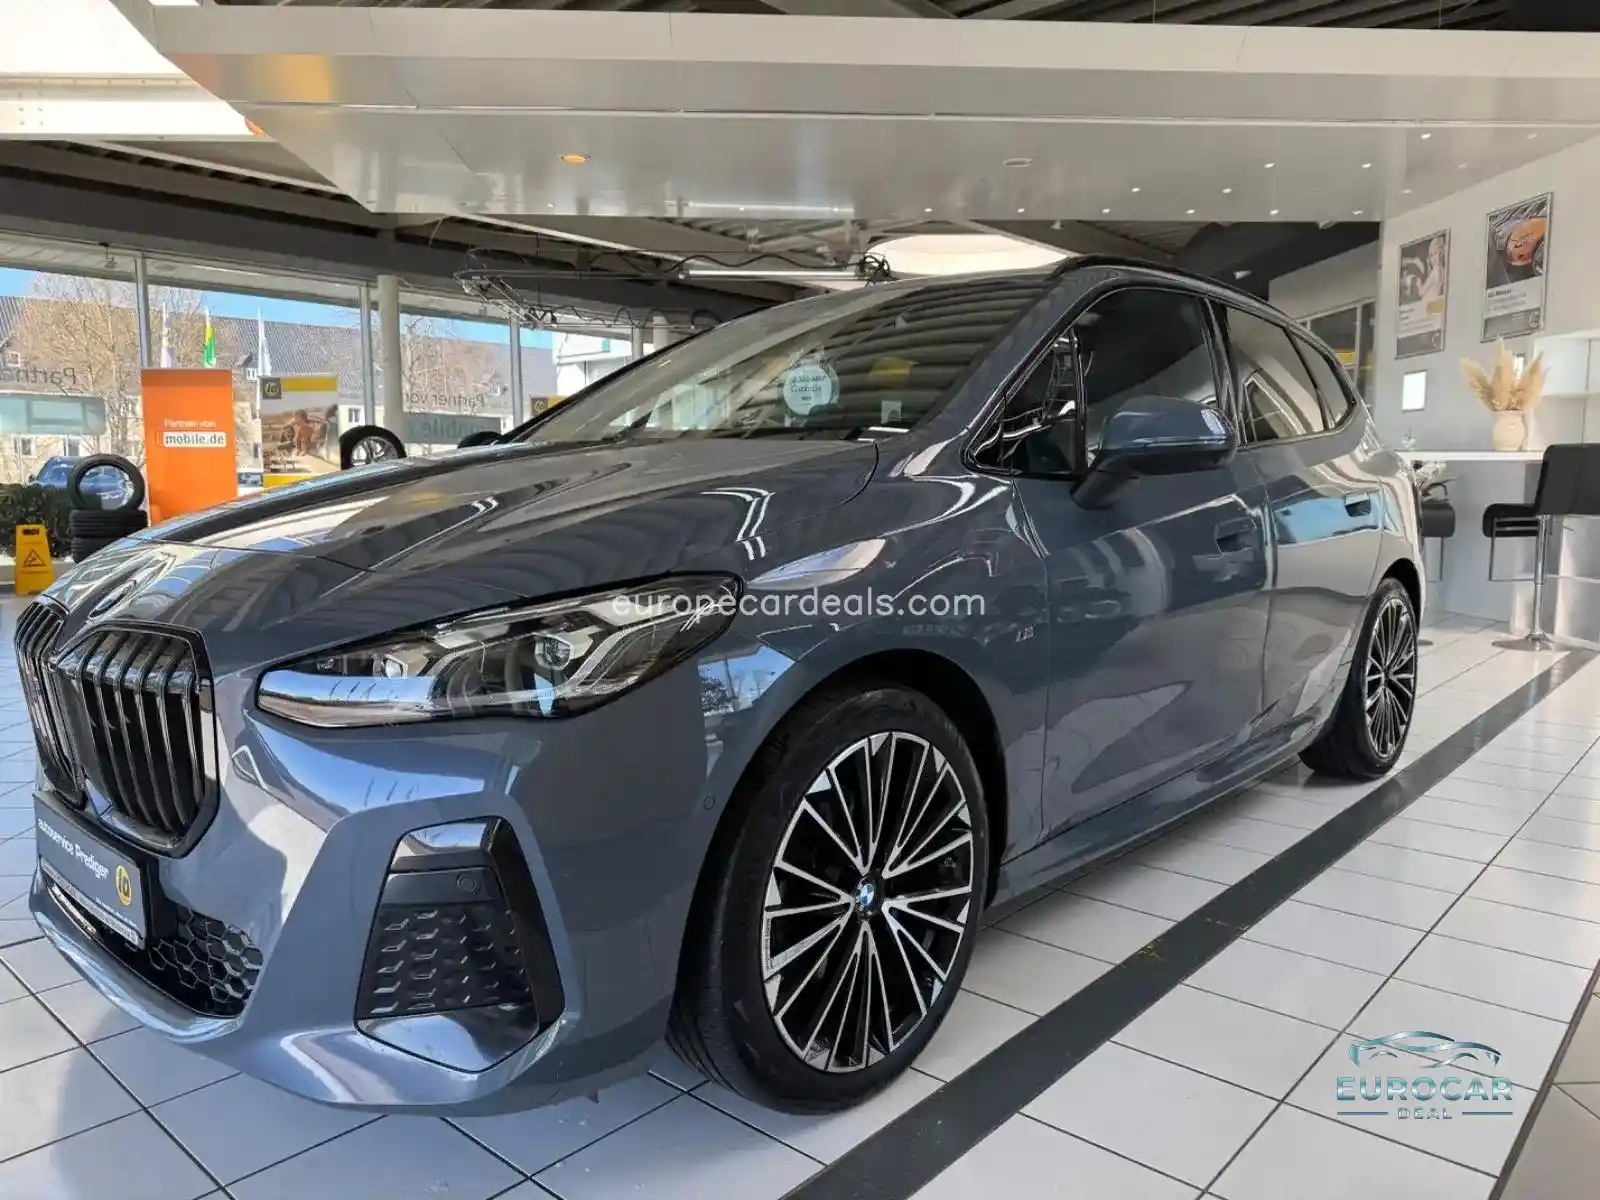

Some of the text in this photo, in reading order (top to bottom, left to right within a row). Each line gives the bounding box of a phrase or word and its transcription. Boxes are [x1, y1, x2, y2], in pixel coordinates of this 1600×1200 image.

[164, 419, 216, 428] Partner von
[165, 432, 224, 445] mobile.de
